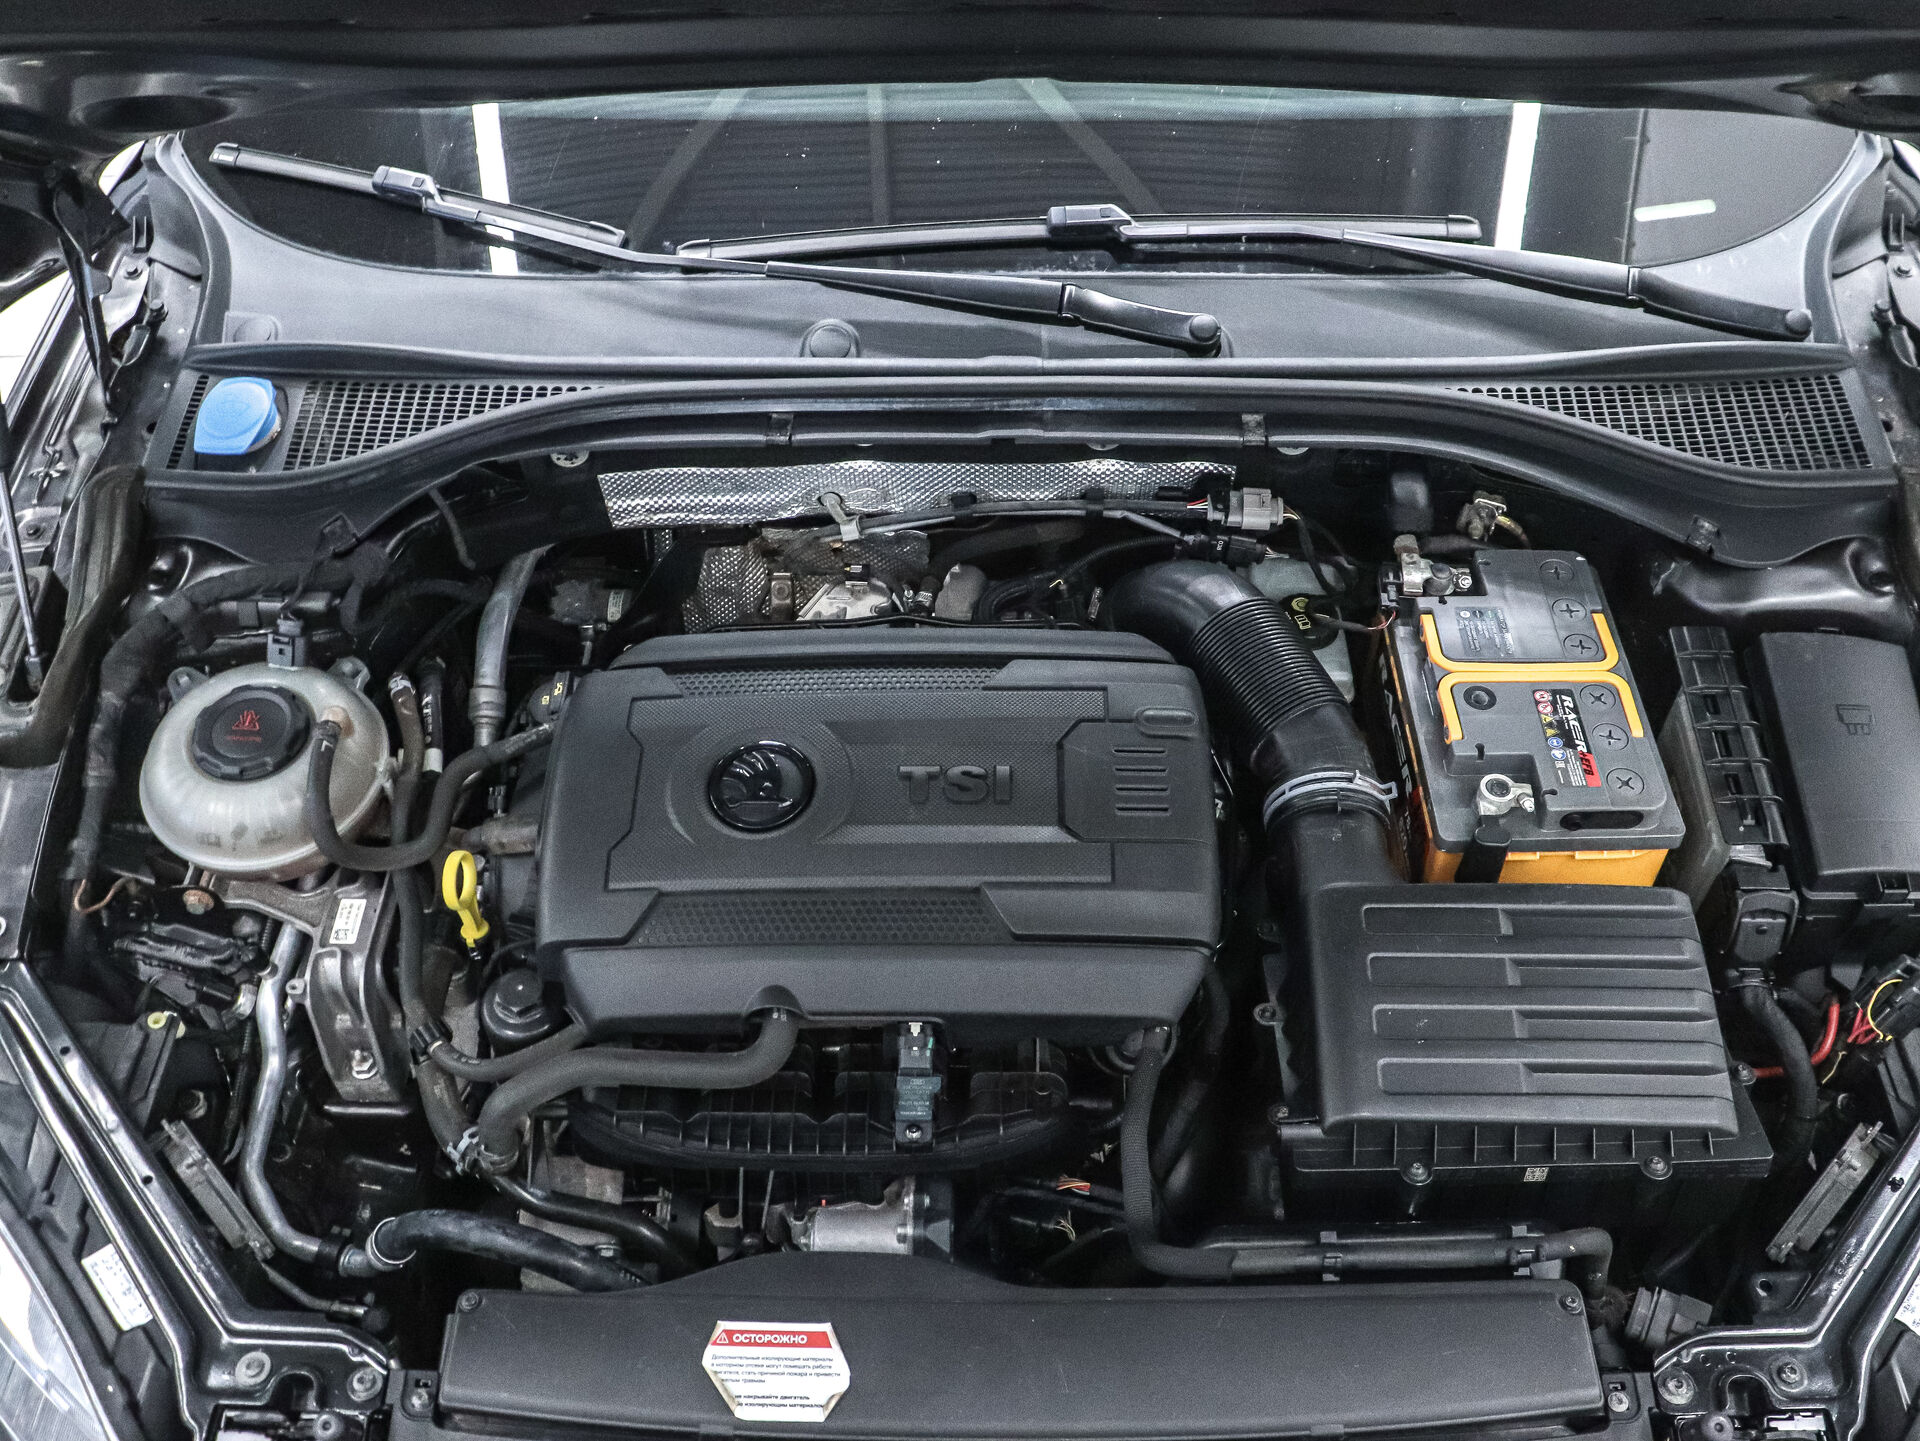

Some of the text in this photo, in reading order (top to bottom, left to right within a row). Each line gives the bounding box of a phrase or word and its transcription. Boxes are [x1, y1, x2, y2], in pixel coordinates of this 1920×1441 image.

[1561, 694, 1588, 753] RACER
[897, 764, 1013, 804] TSI
[732, 1333, 808, 1344] ОСТОРОЖНО
